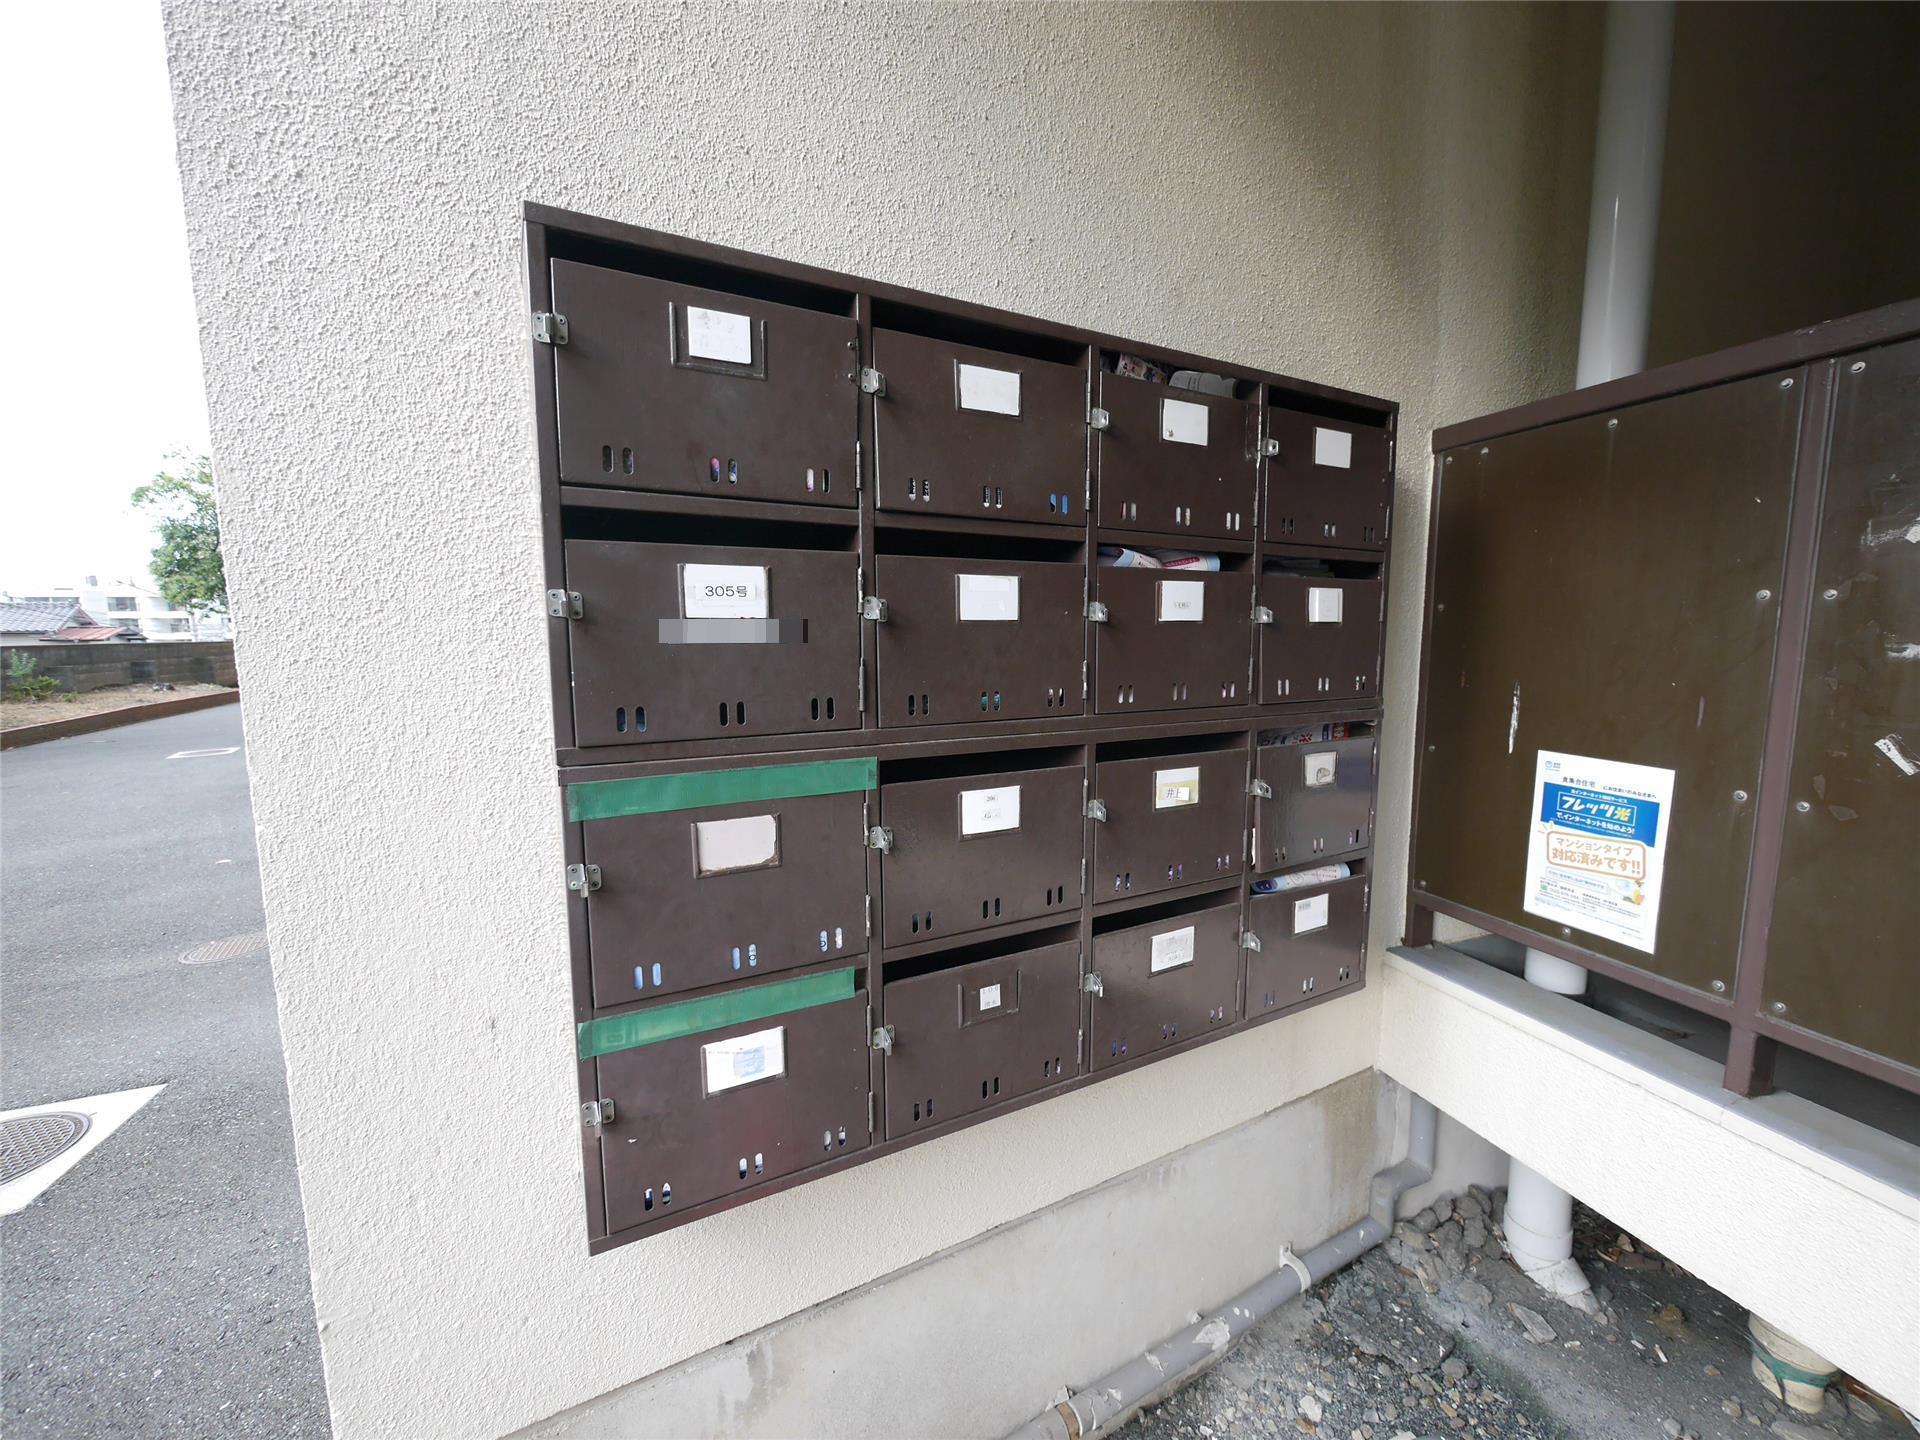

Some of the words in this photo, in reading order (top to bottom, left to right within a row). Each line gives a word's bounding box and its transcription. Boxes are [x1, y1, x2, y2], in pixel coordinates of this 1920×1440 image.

[705, 585, 748, 598] 305号
[1561, 797, 1631, 821] フレッツ光
[1556, 837, 1634, 856] マンションタイプ
